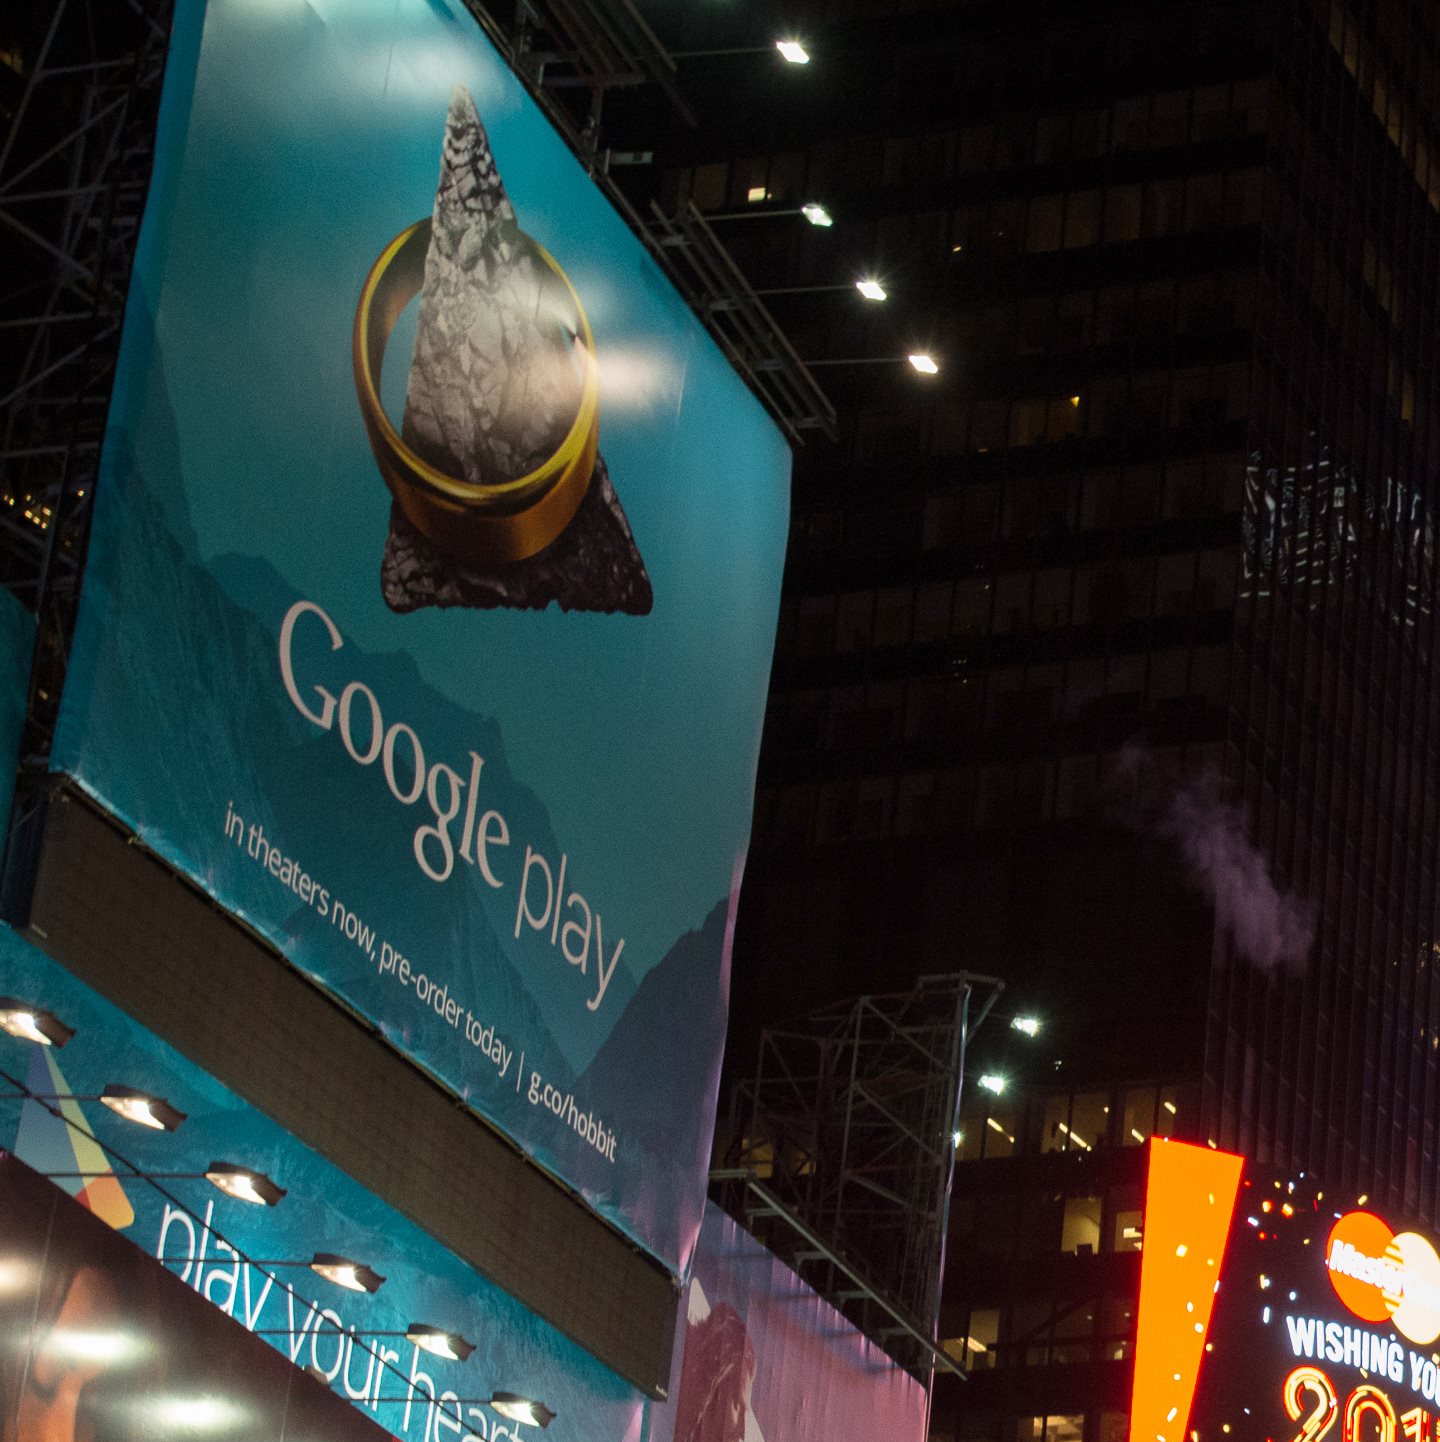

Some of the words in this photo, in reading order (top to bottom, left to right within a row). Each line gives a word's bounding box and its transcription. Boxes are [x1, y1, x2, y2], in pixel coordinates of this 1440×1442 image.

[279, 601, 510, 888] Google
[514, 845, 626, 1011] play
[224, 800, 246, 848] in
[247, 823, 330, 917] theaters
[332, 896, 376, 963] now,
[378, 941, 465, 1030] pre-order
[465, 1009, 512, 1078] today
[526, 1071, 618, 1164] g.co/hobbit
[156, 1199, 274, 1333] play
[1286, 1315, 1404, 1383] WISHING
